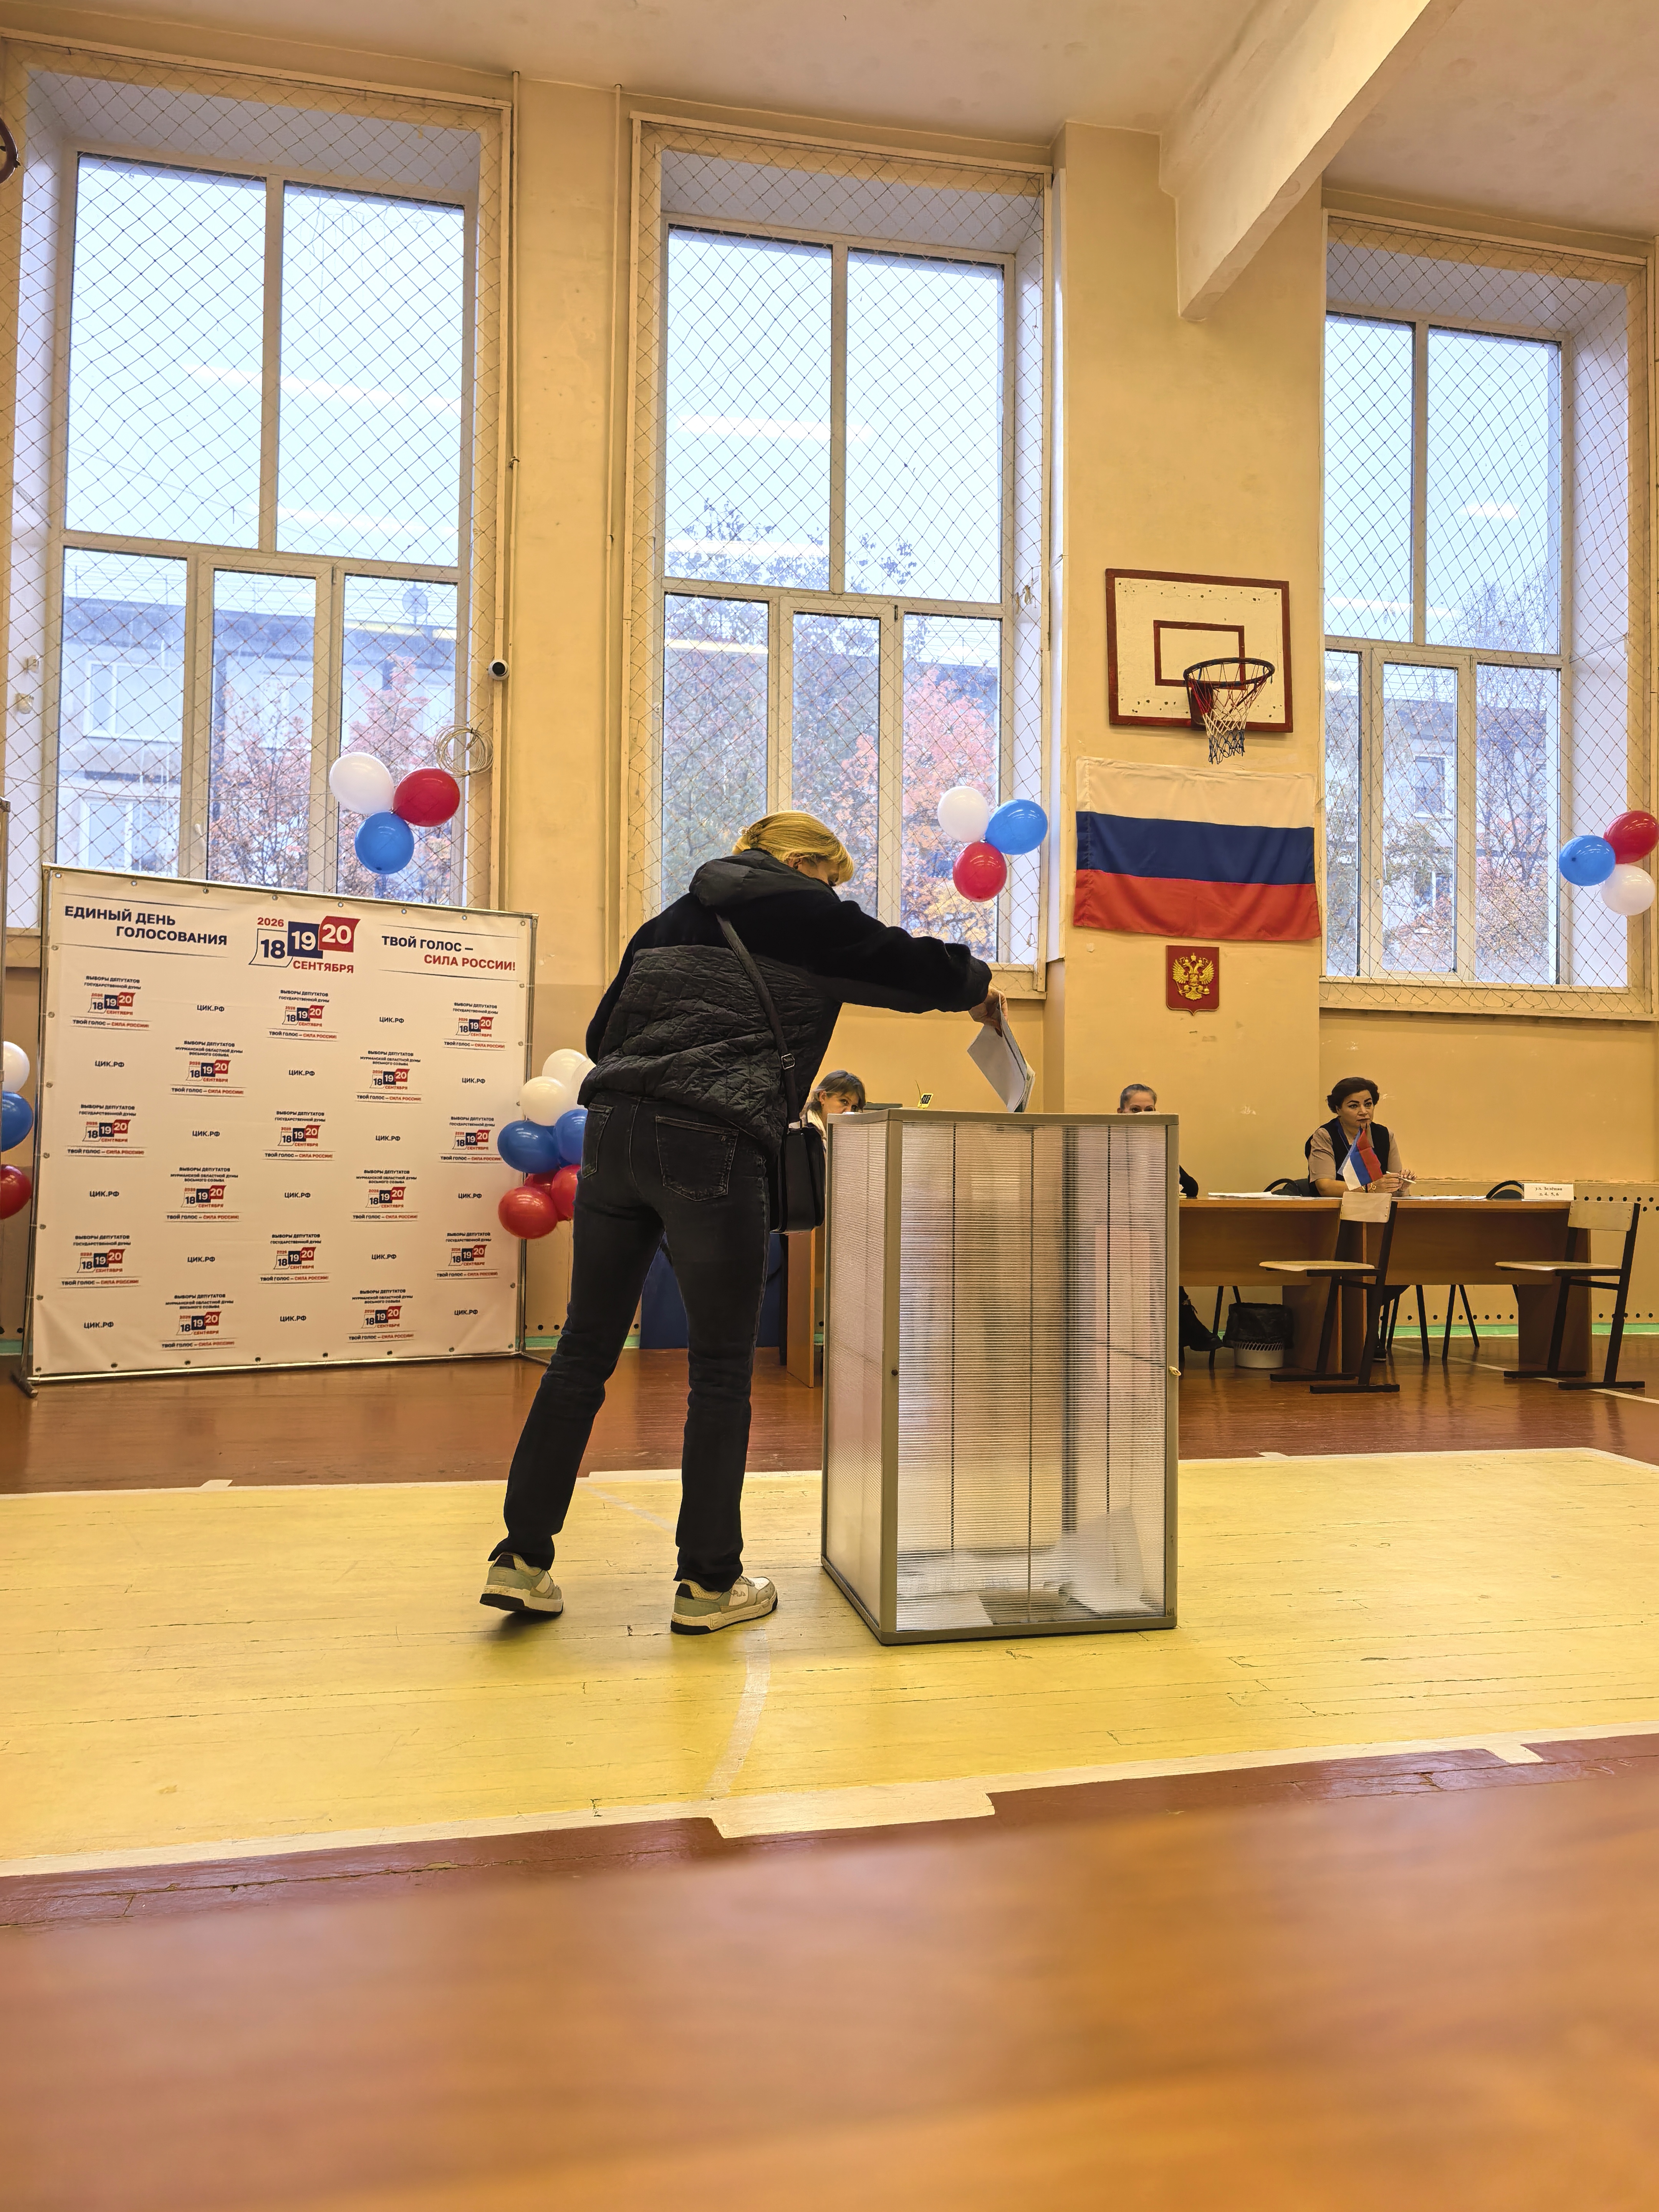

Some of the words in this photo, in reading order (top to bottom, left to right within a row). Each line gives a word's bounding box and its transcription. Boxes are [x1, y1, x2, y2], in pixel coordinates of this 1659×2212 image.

[65, 906, 132, 922] ЕДИНЫЙ
[136, 913, 176, 926] ДЕНЬ
[257, 917, 284, 927] 2026
[116, 926, 227, 945] ГОЛОСОВАНИЯ
[261, 939, 285, 959] 18
[291, 931, 316, 950] 19
[322, 924, 352, 944] 20
[382, 935, 416, 948] ТВОЙ
[420, 939, 461, 952] ГОЛОС
[293, 960, 354, 974] СЕНТЯБРЯ
[424, 954, 458, 966] СИЛА
[462, 957, 516, 971] РОССИИ!
[215, 1063, 227, 1071] 20
[88, 1130, 98, 1138] 18
[114, 1123, 127, 1131] 20
[210, 1188, 222, 1196] 20
[82, 1261, 92, 1269] 18
[96, 1257, 106, 1265] 19
[205, 1315, 218, 1323] 20
